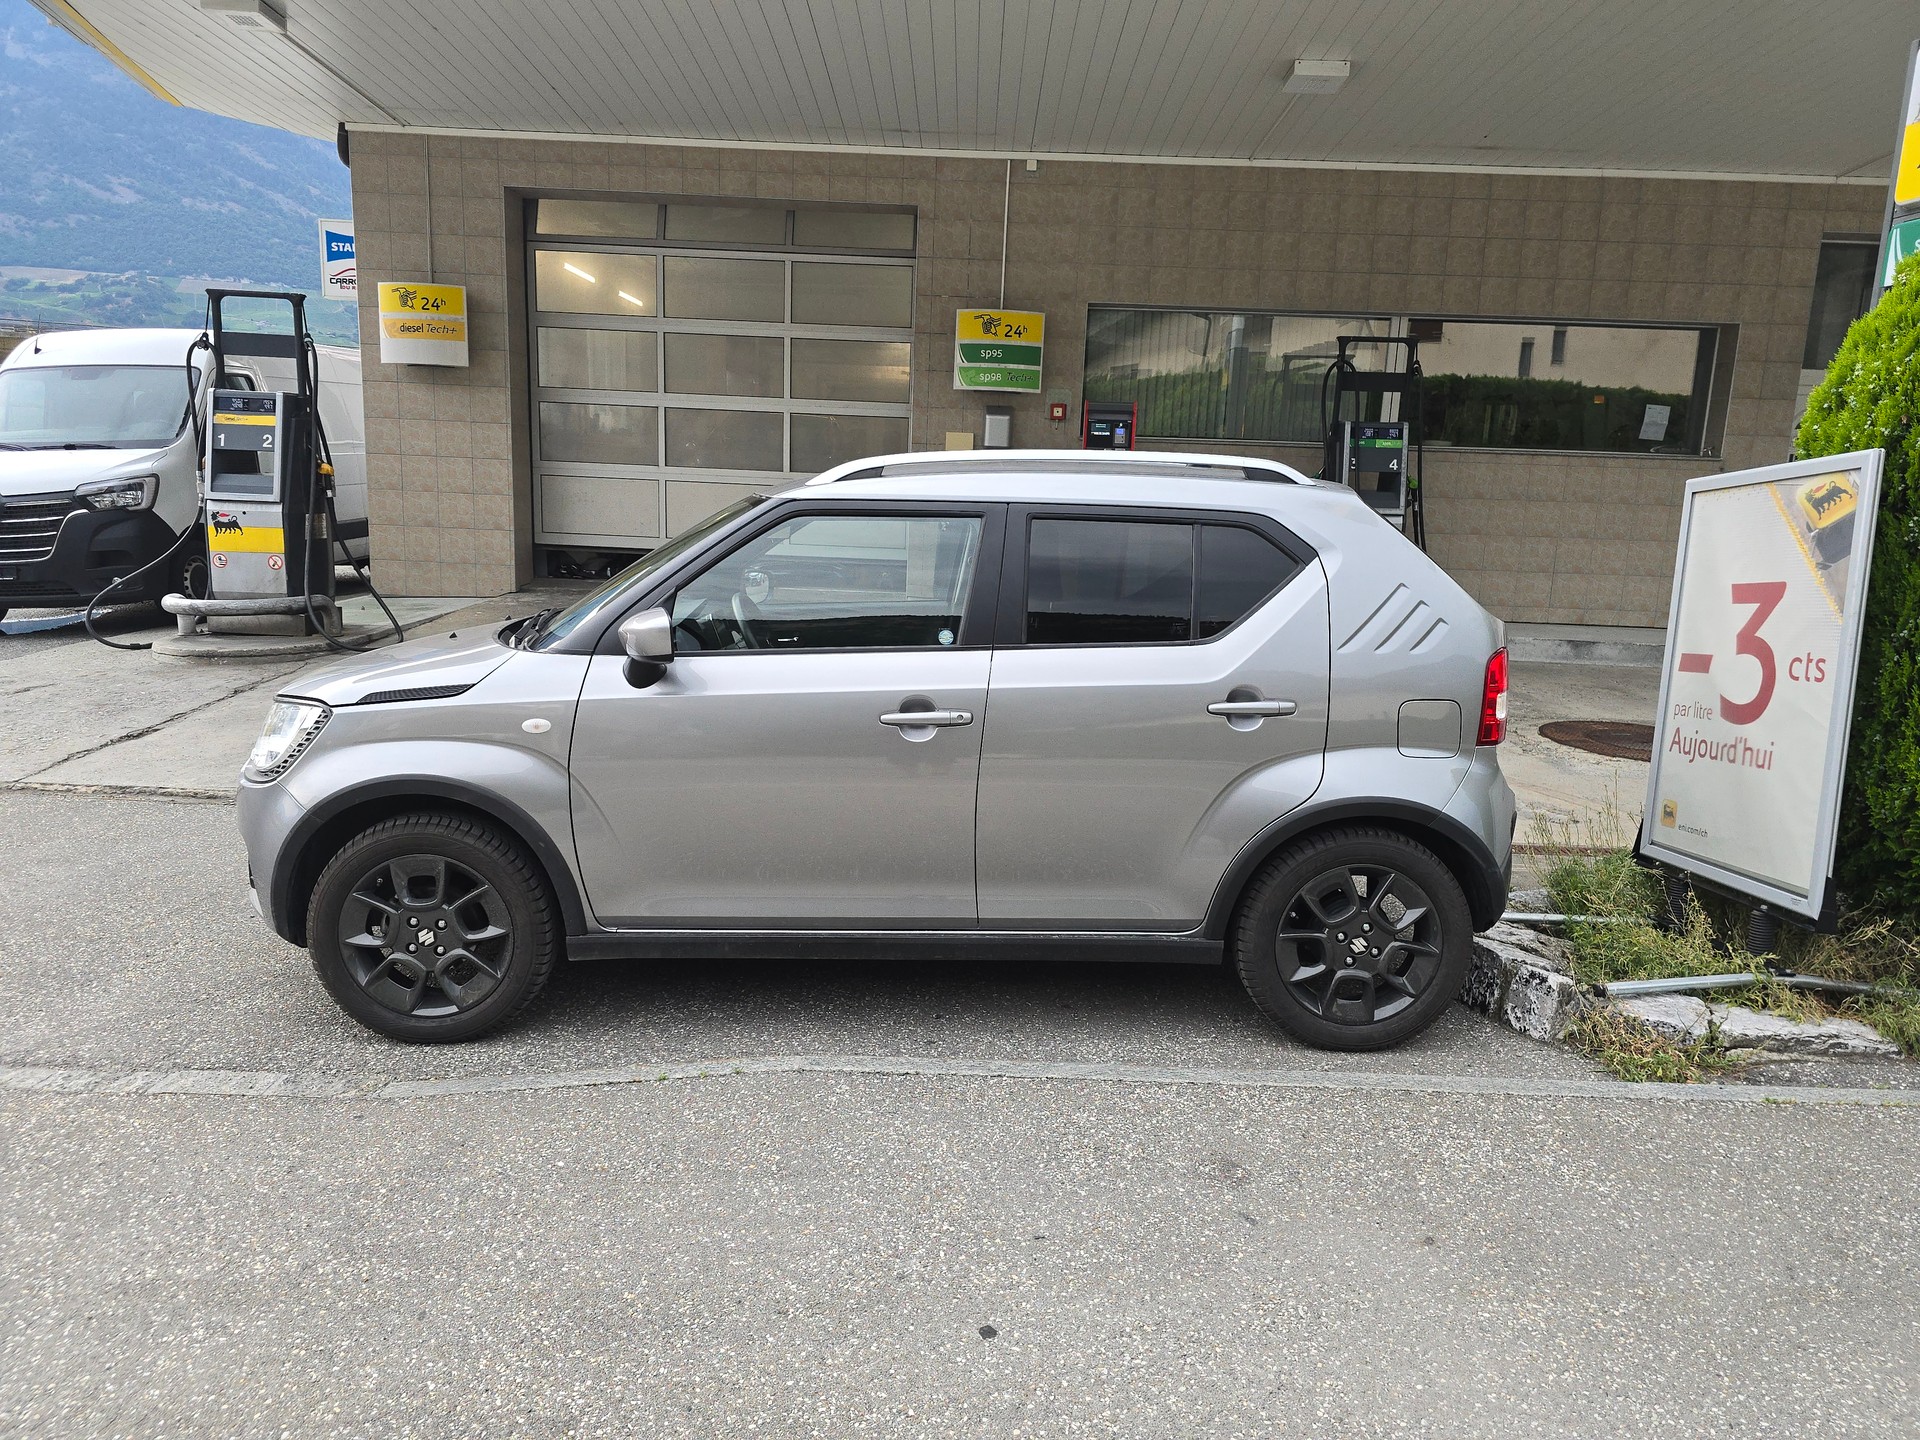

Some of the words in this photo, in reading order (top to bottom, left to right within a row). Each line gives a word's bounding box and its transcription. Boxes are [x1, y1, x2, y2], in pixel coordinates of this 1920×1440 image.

[331, 242, 355, 252] STA
[400, 322, 424, 333] diesel
[426, 323, 457, 334] Tech+
[980, 349, 1003, 360] sp95
[979, 372, 1002, 383] sp98
[217, 433, 225, 447] 1
[262, 433, 273, 448] 2
[1389, 459, 1399, 471] 4
[1788, 652, 1827, 683] cts
[1673, 703, 1692, 720] par
[1693, 701, 1713, 721] litre
[1668, 726, 1775, 771] Aujourd'hui
[1678, 823, 1709, 838] eni.com/ch
